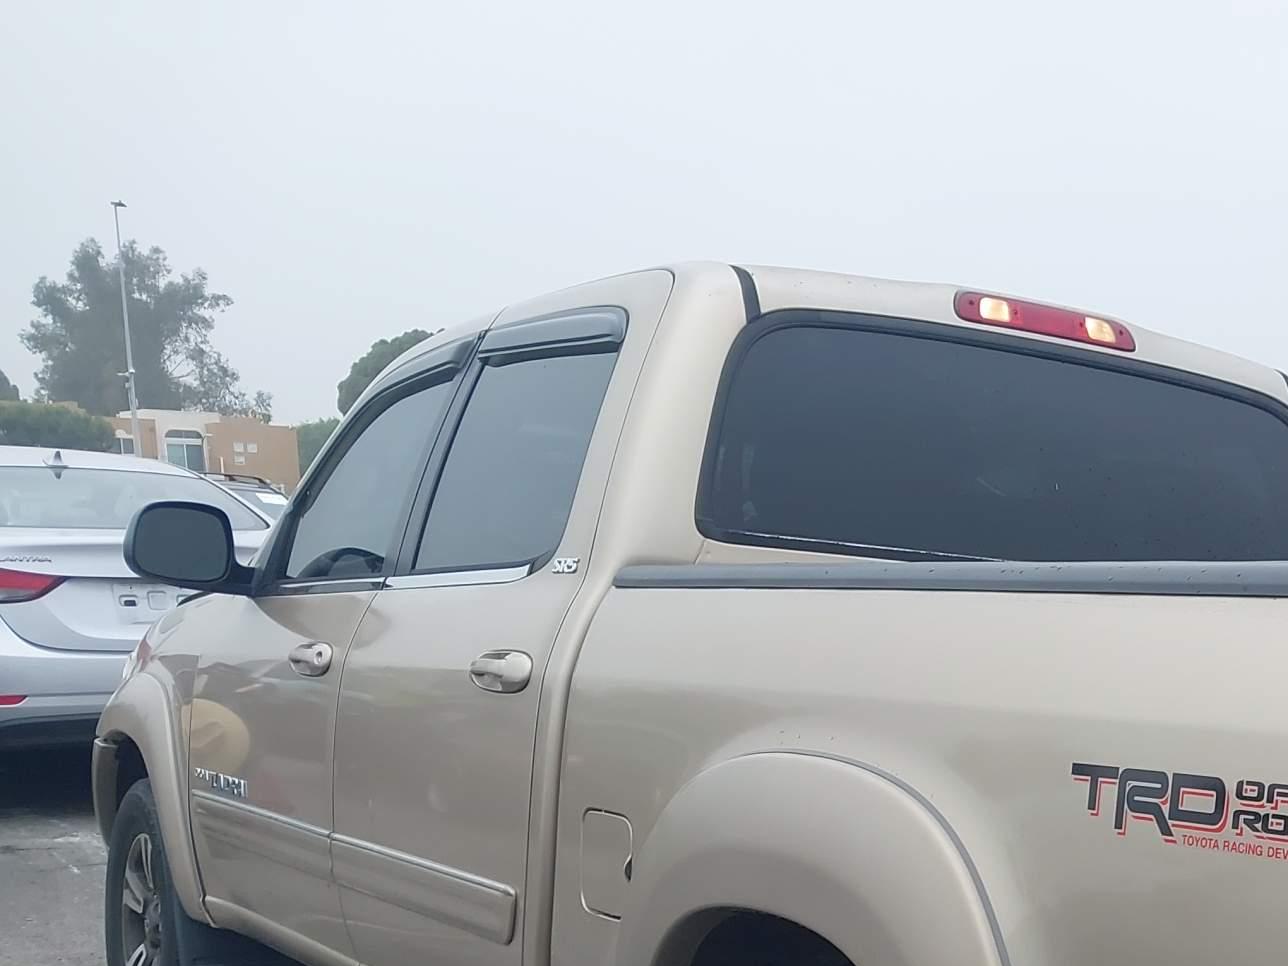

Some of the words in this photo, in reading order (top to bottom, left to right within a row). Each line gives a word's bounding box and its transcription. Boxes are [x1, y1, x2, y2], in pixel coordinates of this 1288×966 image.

[1070, 762, 1230, 845] TRD
[1181, 834, 1219, 851] TOYOTA
[1222, 840, 1264, 857] RACING
